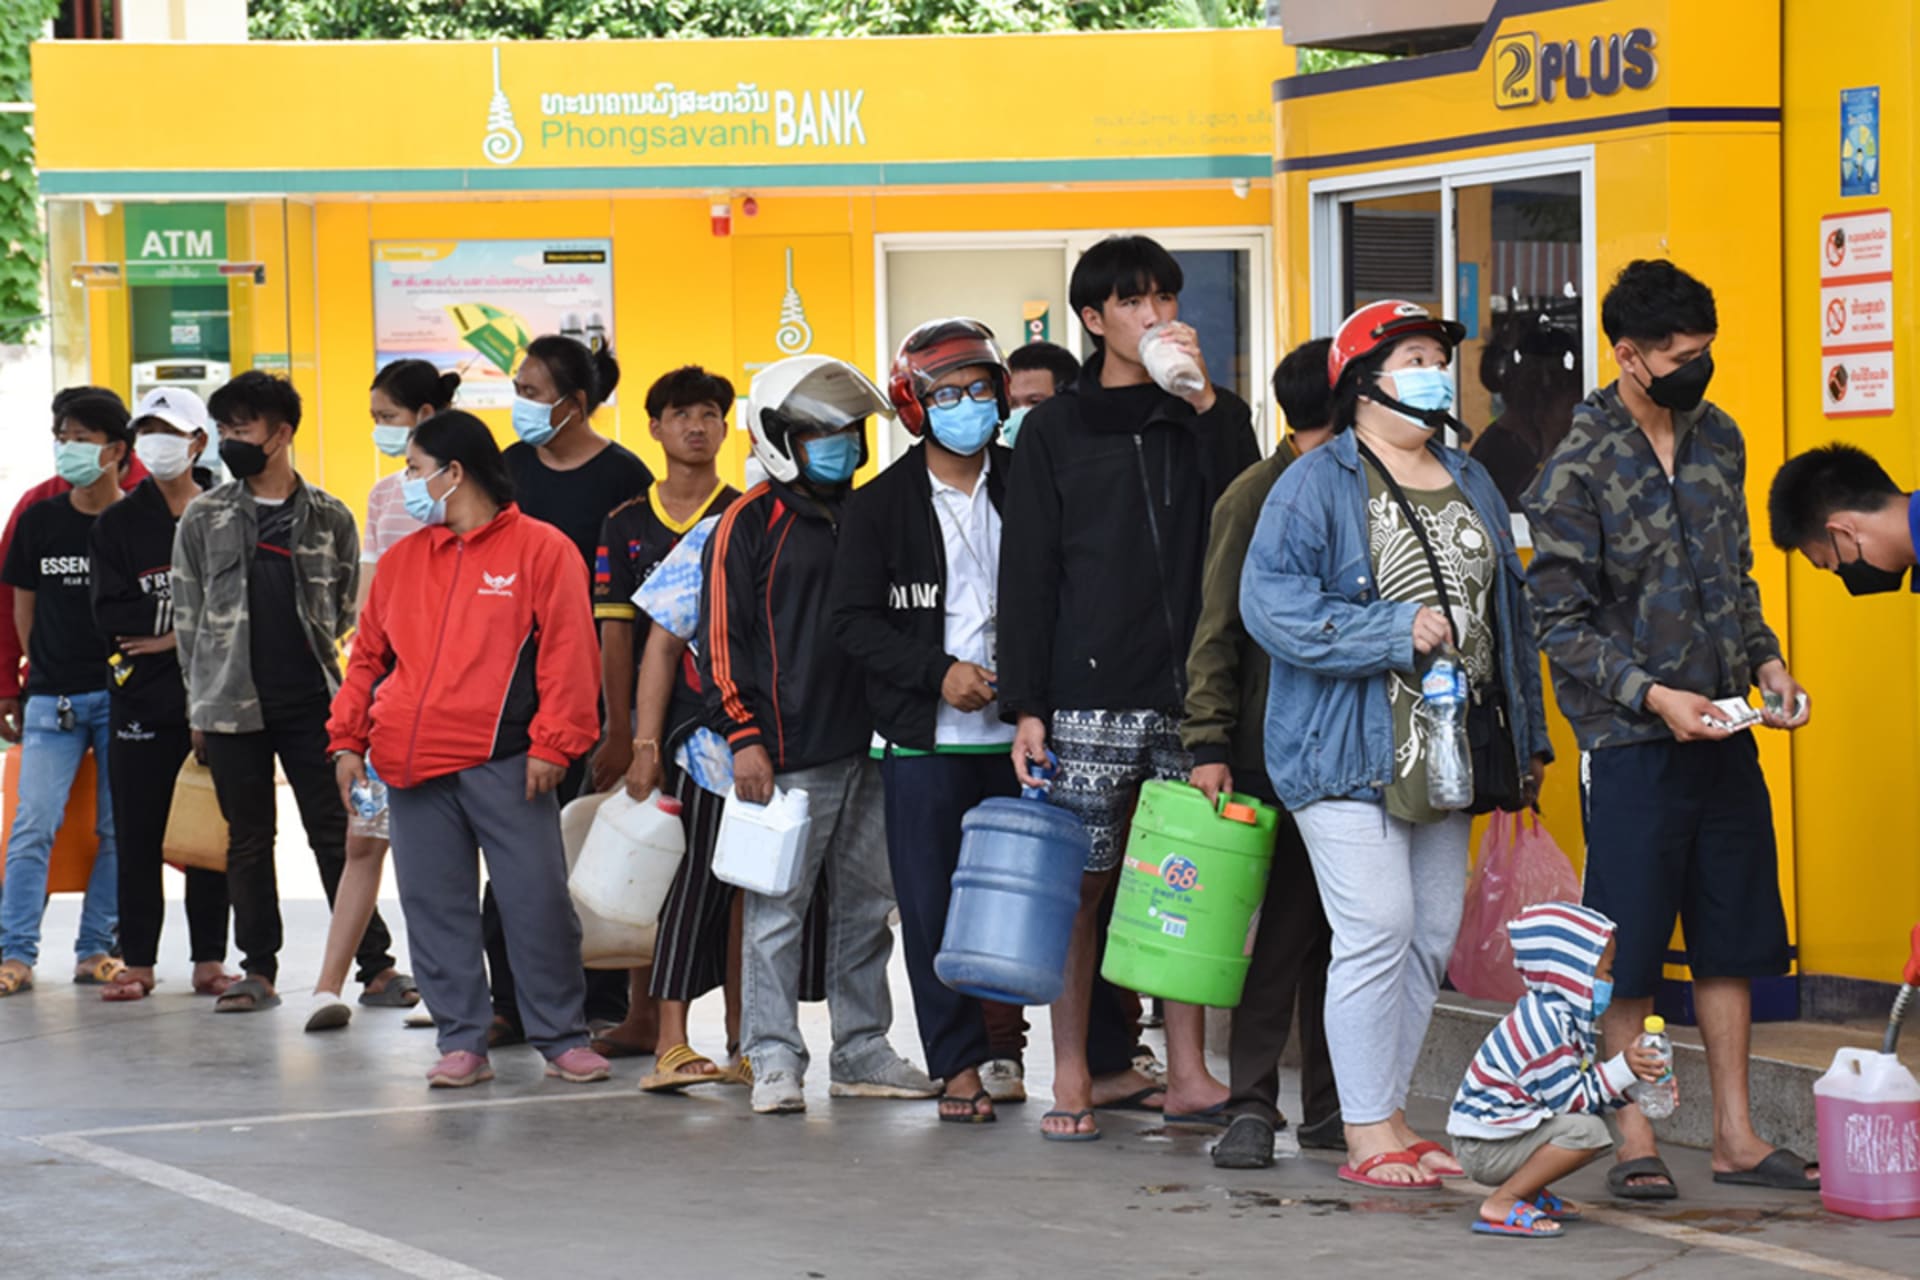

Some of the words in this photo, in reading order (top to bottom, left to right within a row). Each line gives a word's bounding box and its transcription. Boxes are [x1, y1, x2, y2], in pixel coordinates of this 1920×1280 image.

[1541, 27, 1658, 102] PLUS
[775, 89, 866, 146] BANK
[541, 120, 767, 155] Phongsavanh
[141, 230, 213, 257] ATM
[40, 556, 90, 575] ESSEN
[1165, 863, 1198, 889] 68
